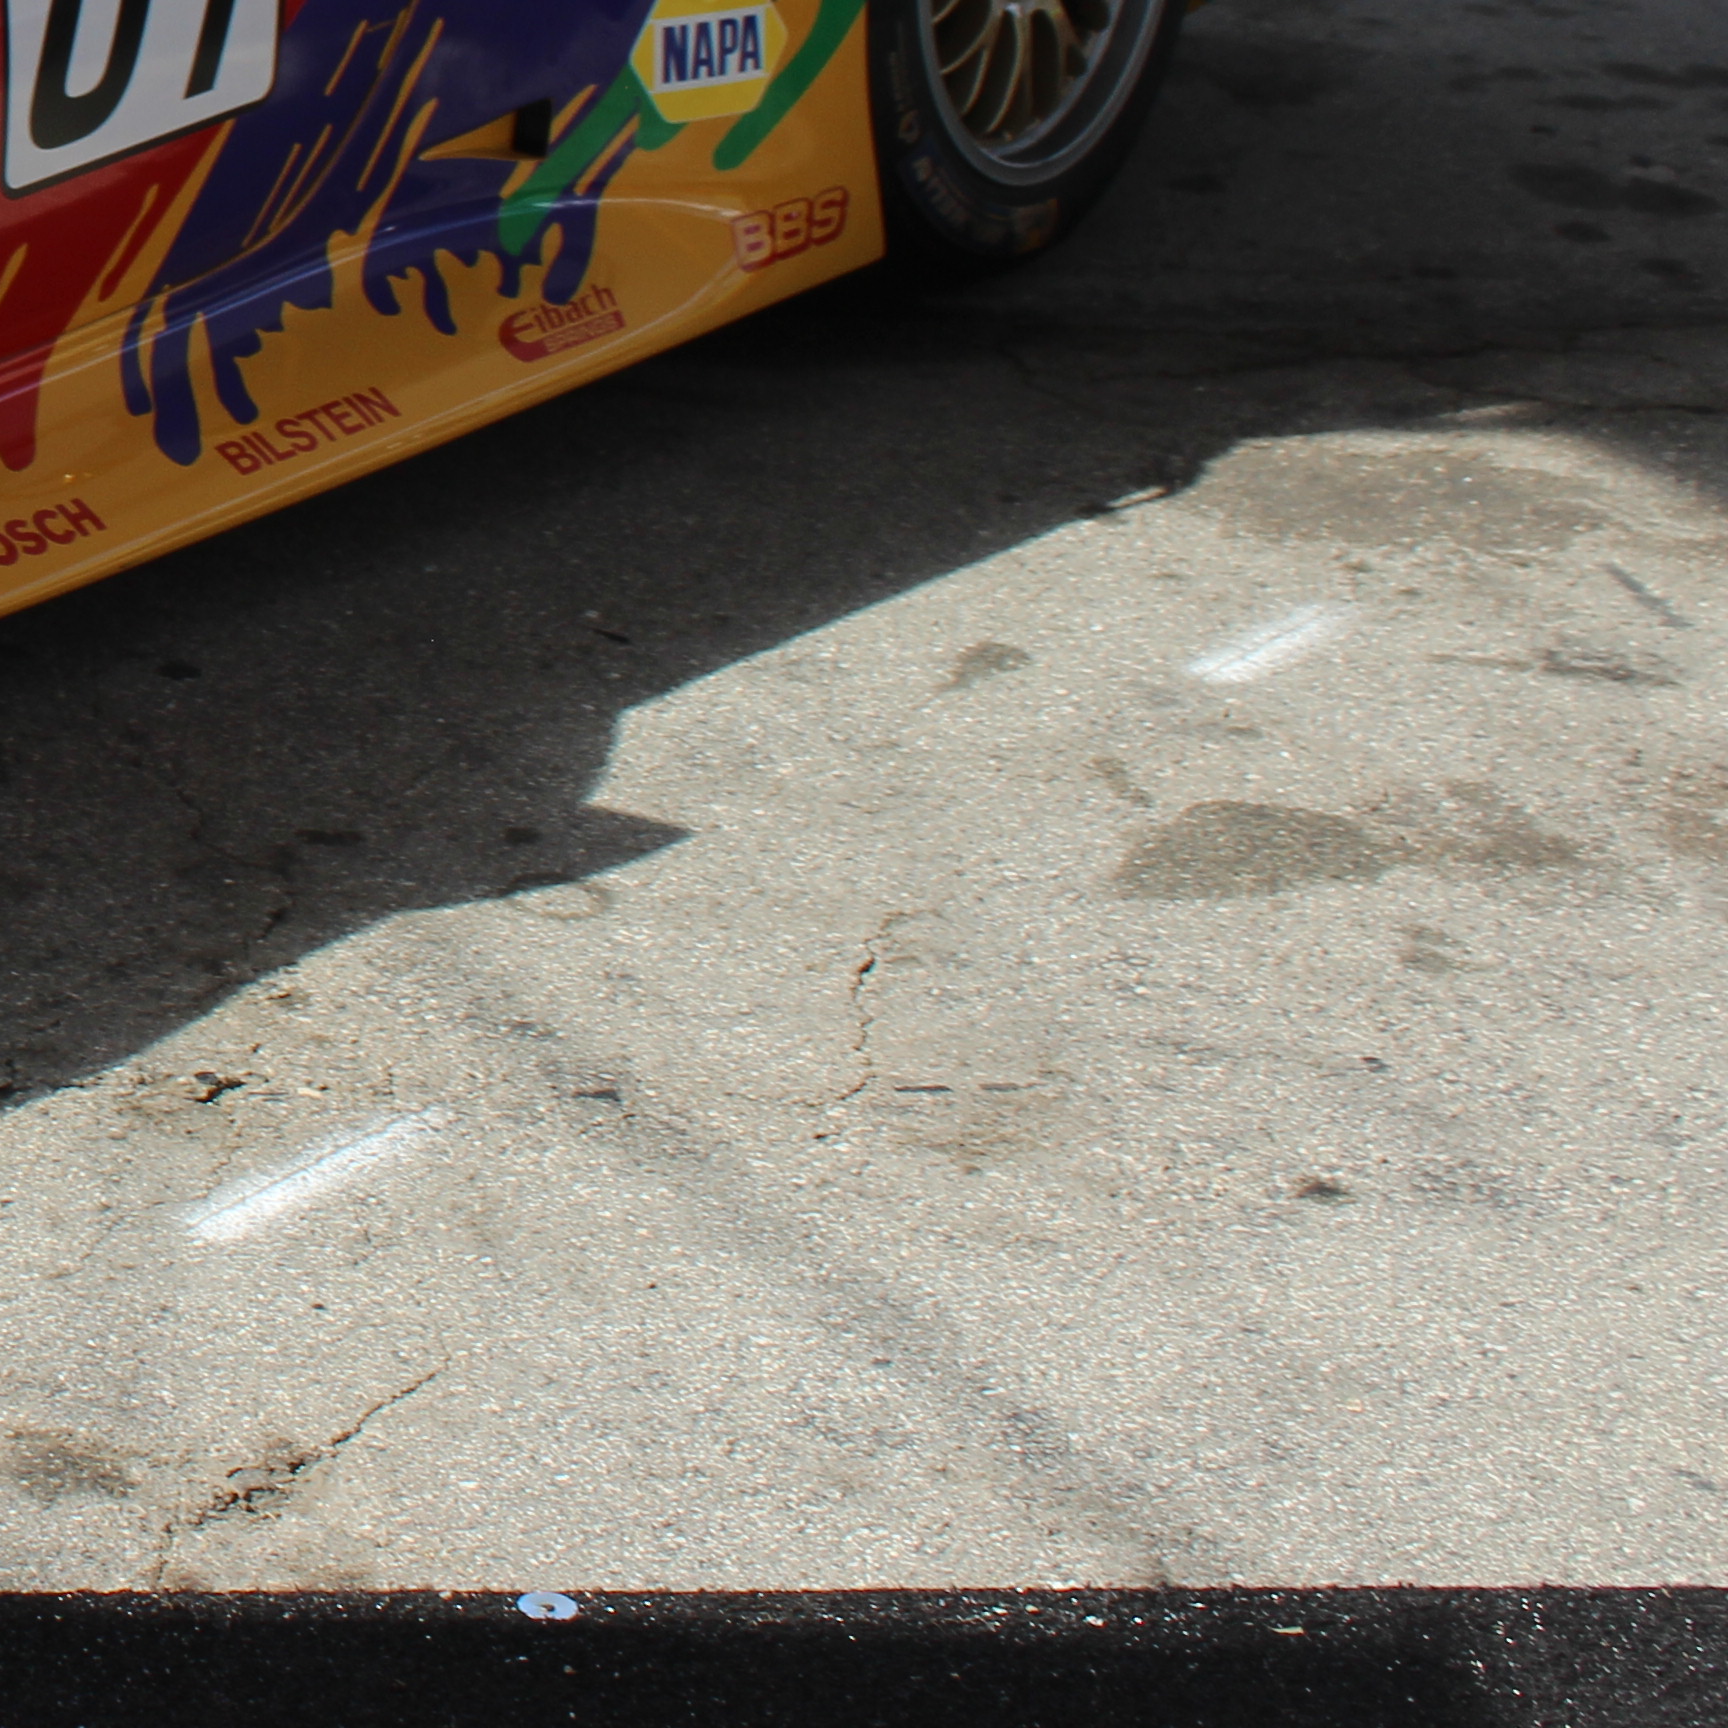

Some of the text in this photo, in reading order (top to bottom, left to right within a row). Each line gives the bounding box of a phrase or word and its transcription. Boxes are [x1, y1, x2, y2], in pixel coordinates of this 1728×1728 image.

[661, 13, 762, 85] NAPA
[732, 185, 850, 272] BBS
[497, 284, 619, 363] Eibach
[214, 385, 404, 477] BILSTEIN
